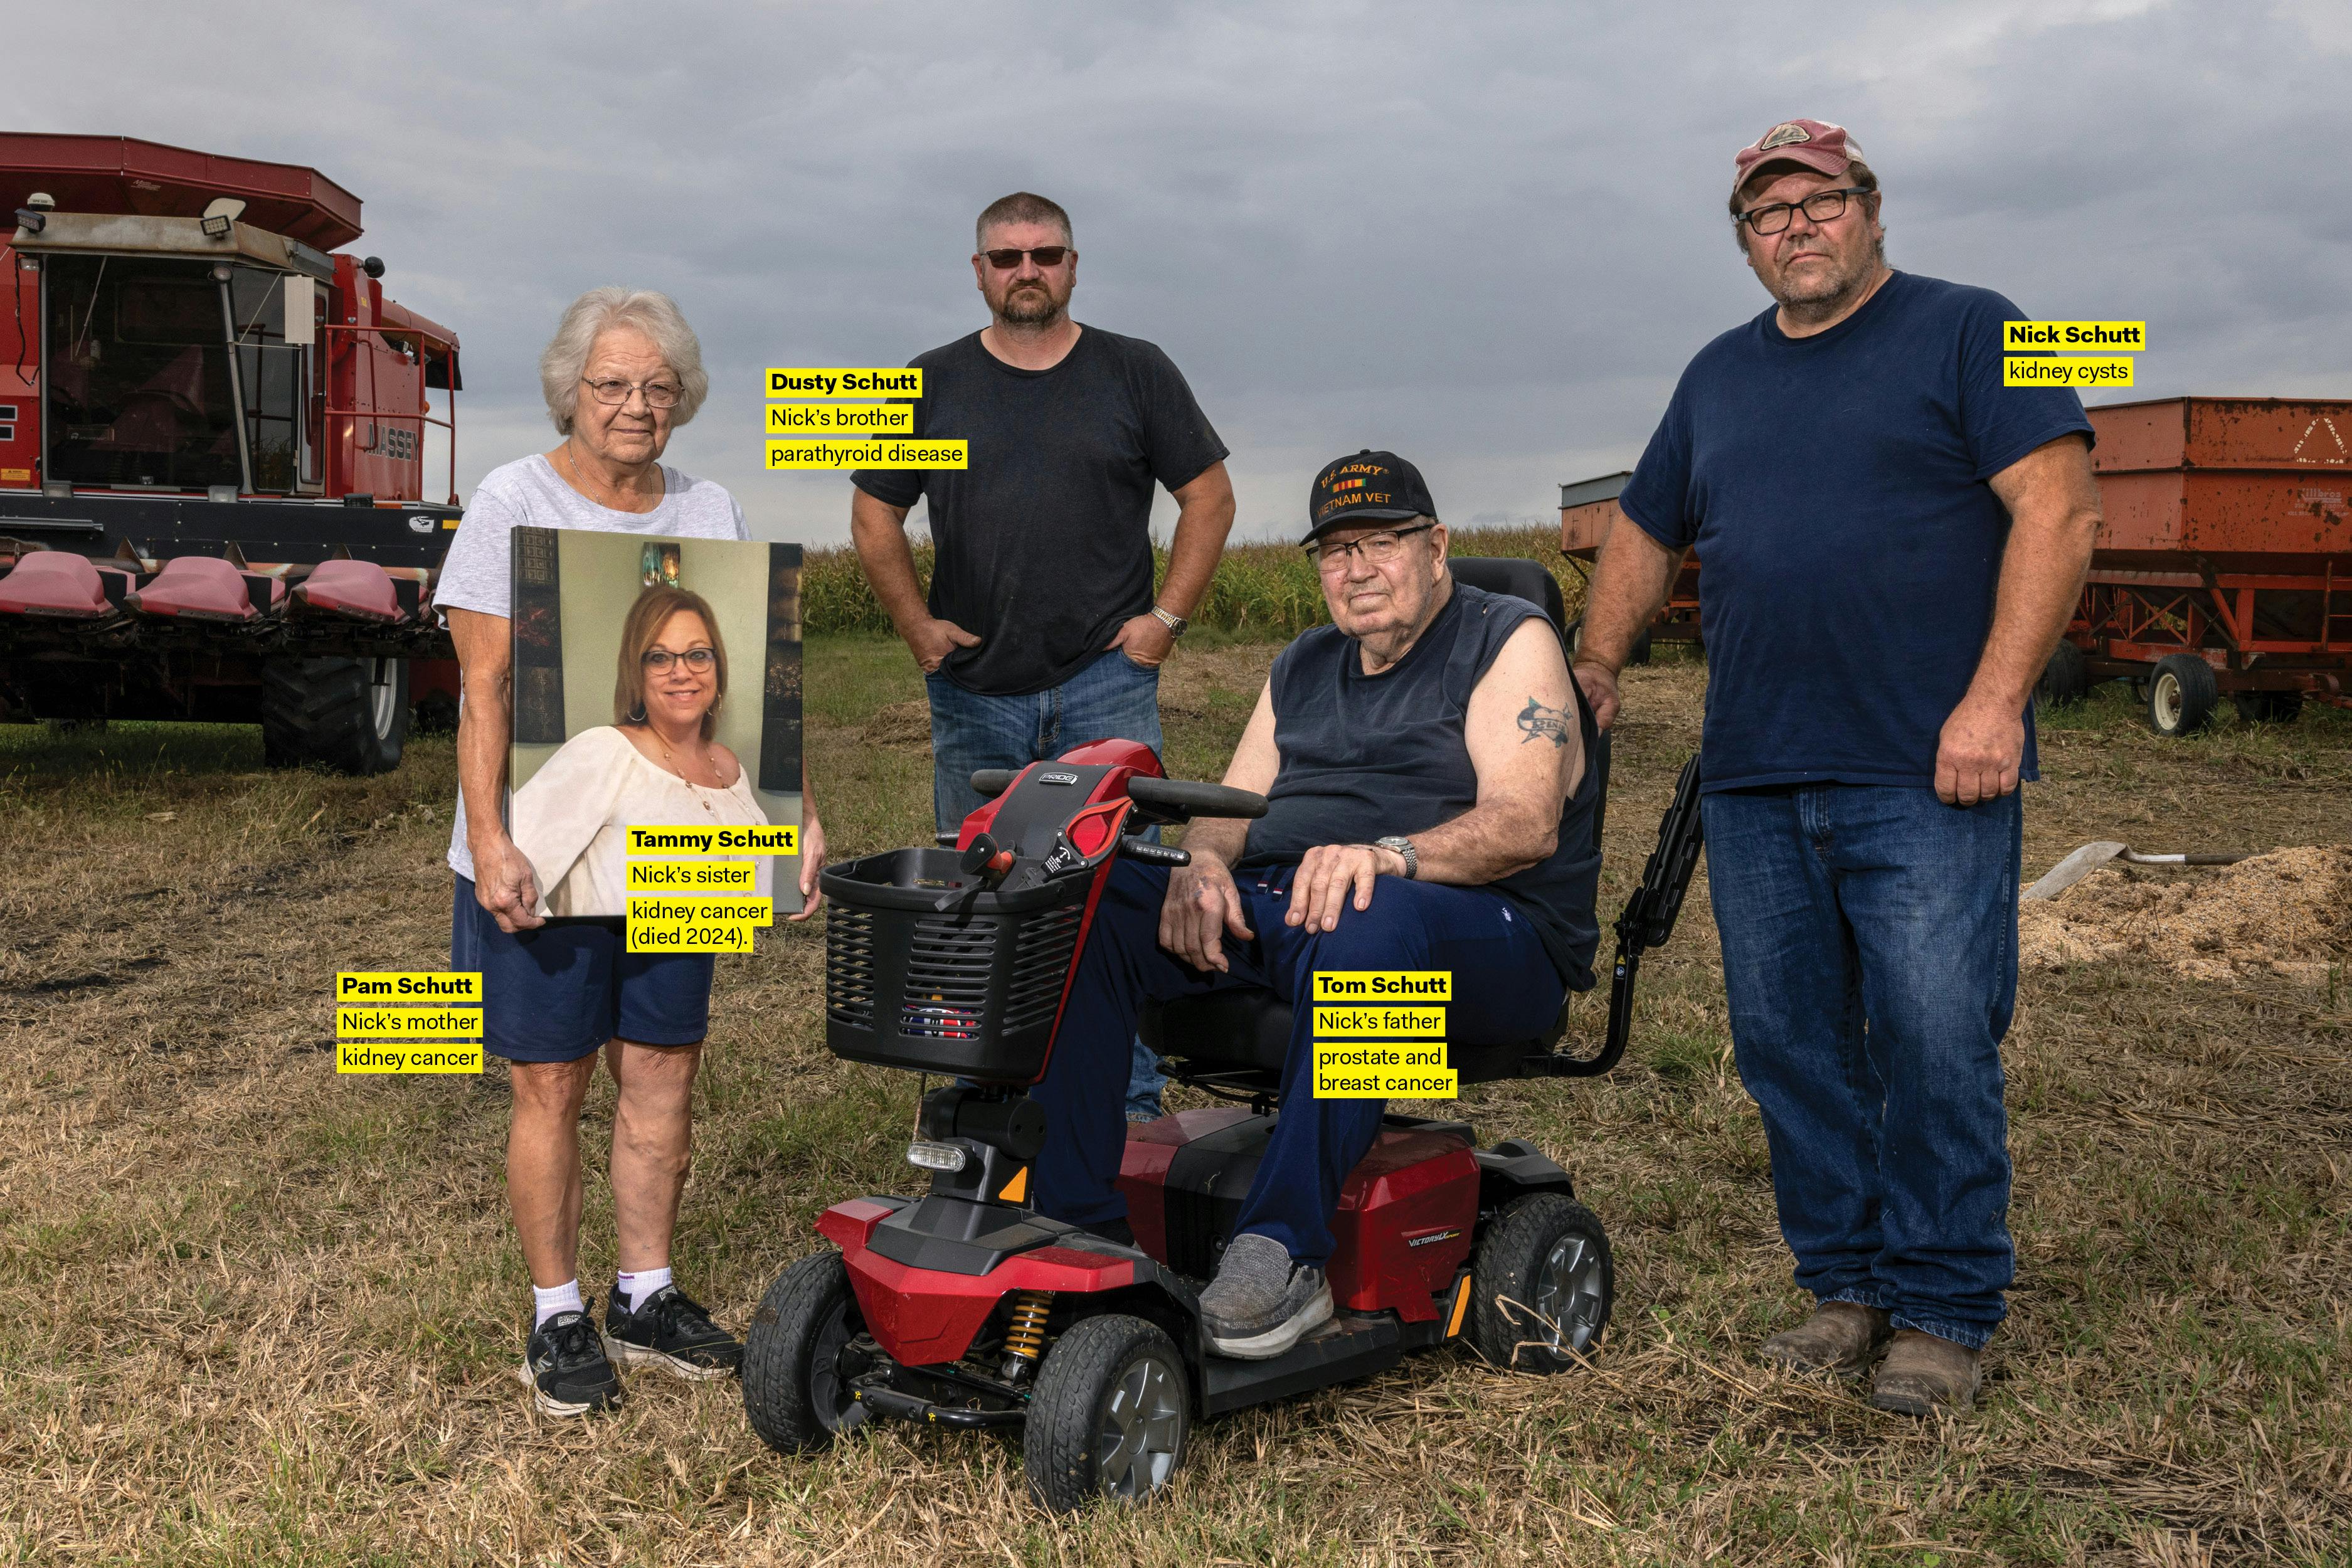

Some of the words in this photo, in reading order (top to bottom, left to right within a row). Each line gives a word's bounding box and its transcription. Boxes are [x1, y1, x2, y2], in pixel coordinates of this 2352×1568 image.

[1321, 470, 1337, 489] U.S.
[1317, 493, 1361, 519] VIETNAM
[1365, 492, 1391, 503] VET
